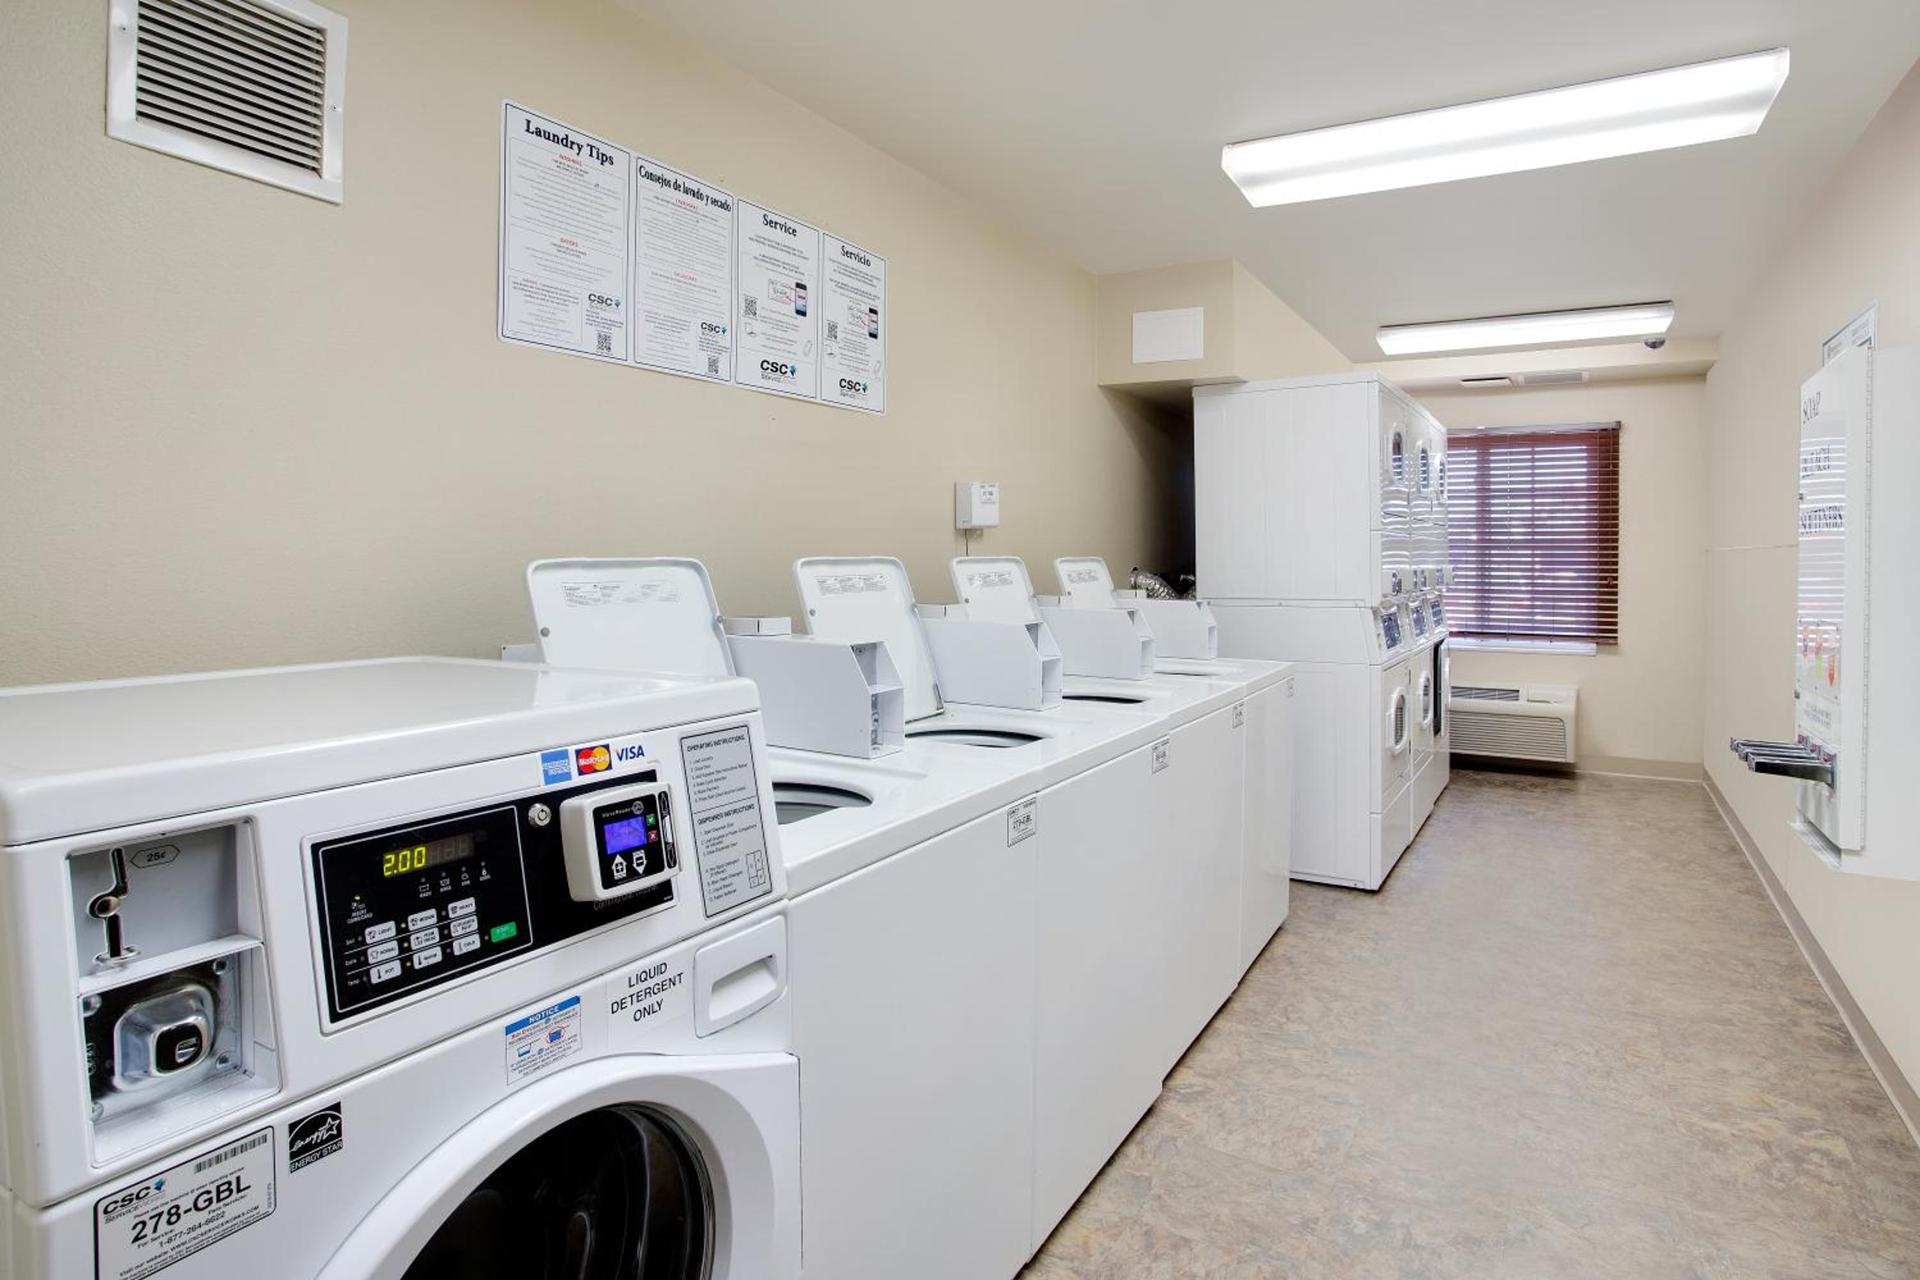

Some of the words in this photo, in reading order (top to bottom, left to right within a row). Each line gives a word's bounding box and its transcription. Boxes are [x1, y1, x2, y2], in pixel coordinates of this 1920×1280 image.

[525, 119, 583, 156] Laundry
[586, 143, 614, 166] Tips
[639, 165, 671, 188] Consejos
[673, 179, 681, 192] de
[683, 182, 704, 201] lavado
[705, 194, 709, 206] y
[711, 197, 731, 212] secado
[763, 214, 797, 236] Service
[841, 245, 871, 267] Servicio
[588, 293, 613, 307] CSC
[700, 322, 720, 334] CSC
[760, 360, 788, 375] CSC
[839, 378, 861, 392] CSC
[617, 745, 645, 762] VISA
[686, 741, 713, 752] OPERATING
[713, 734, 744, 746] INSTRUCTIONS
[697, 812, 723, 826] DISPENSER
[724, 802, 754, 818] INSTRUCTIONS
[383, 846, 426, 877] 2.00
[628, 962, 667, 988] LIQUID
[611, 972, 684, 1014] DETERGENT
[528, 1006, 560, 1024] NOTICE
[633, 999, 664, 1022] ONLY
[290, 1151, 321, 1172] ENERGY
[322, 1141, 343, 1157] STAR
[103, 1184, 150, 1217] CSC
[131, 1169, 250, 1245] 278-GBL
[137, 1239, 148, 1249] For
